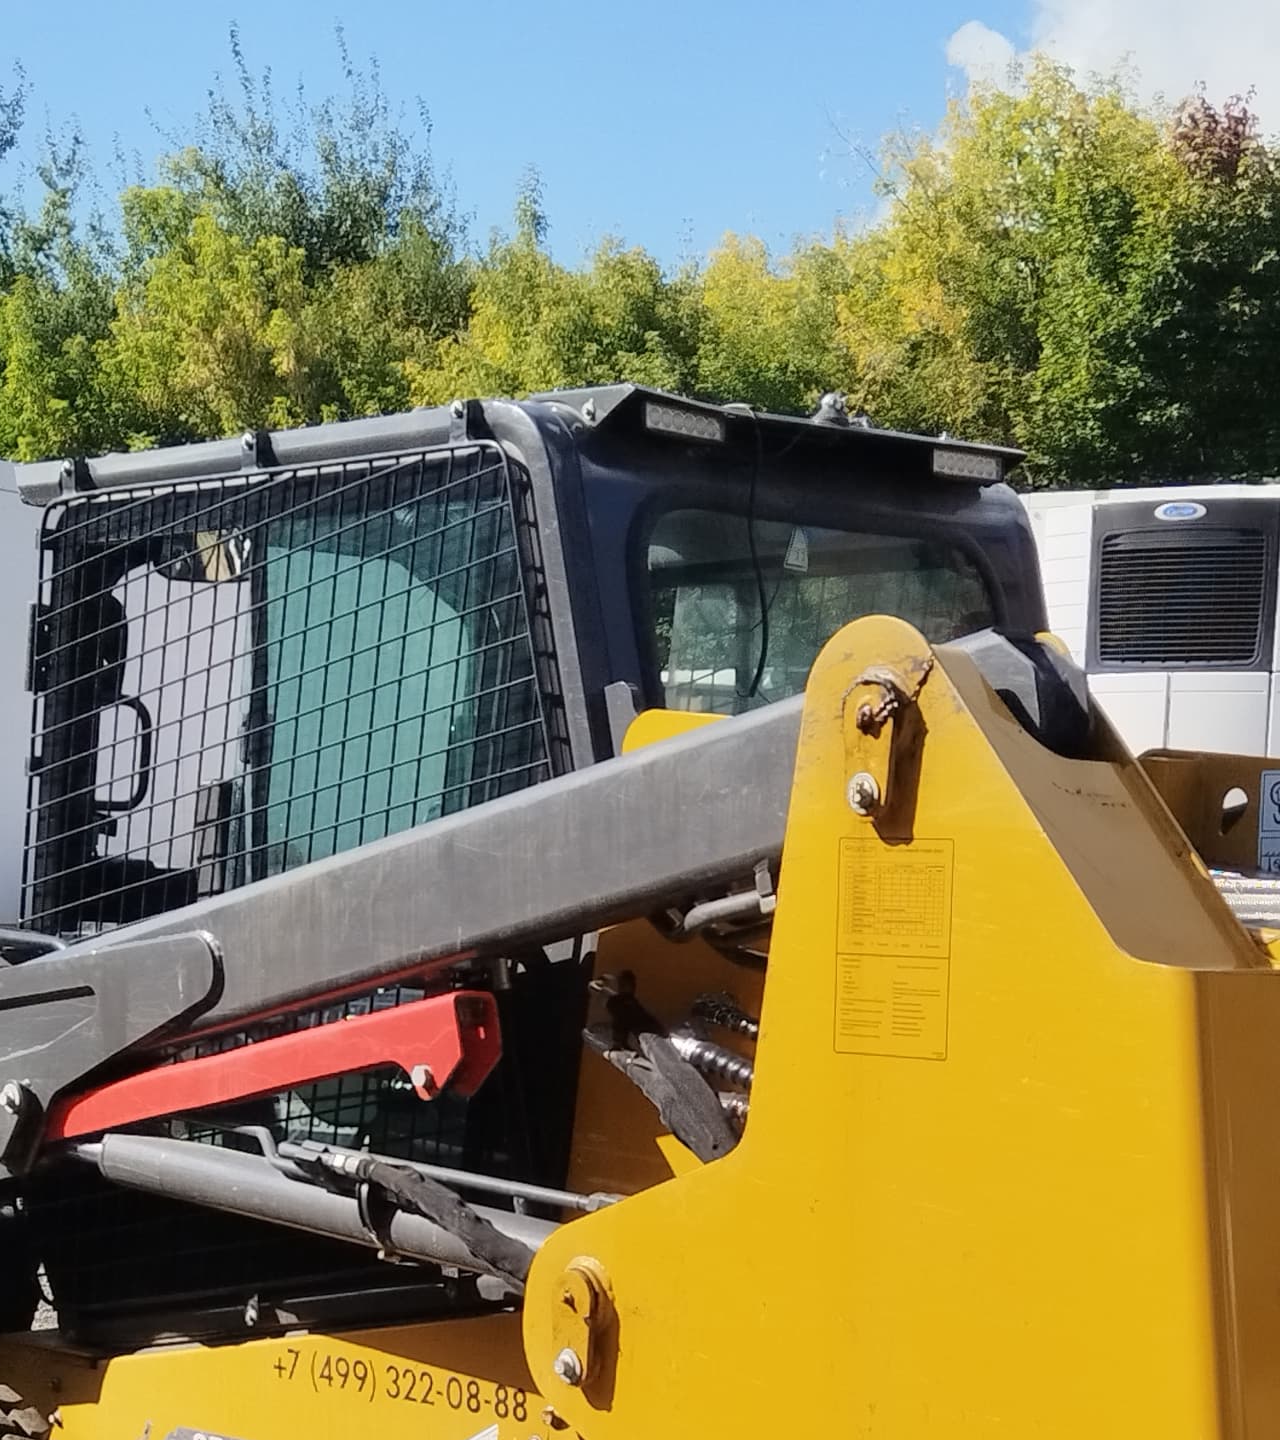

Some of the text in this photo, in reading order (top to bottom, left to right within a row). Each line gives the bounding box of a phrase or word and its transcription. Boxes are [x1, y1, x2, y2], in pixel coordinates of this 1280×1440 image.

[273, 1348, 528, 1422] +7 (499) 322-08-88
